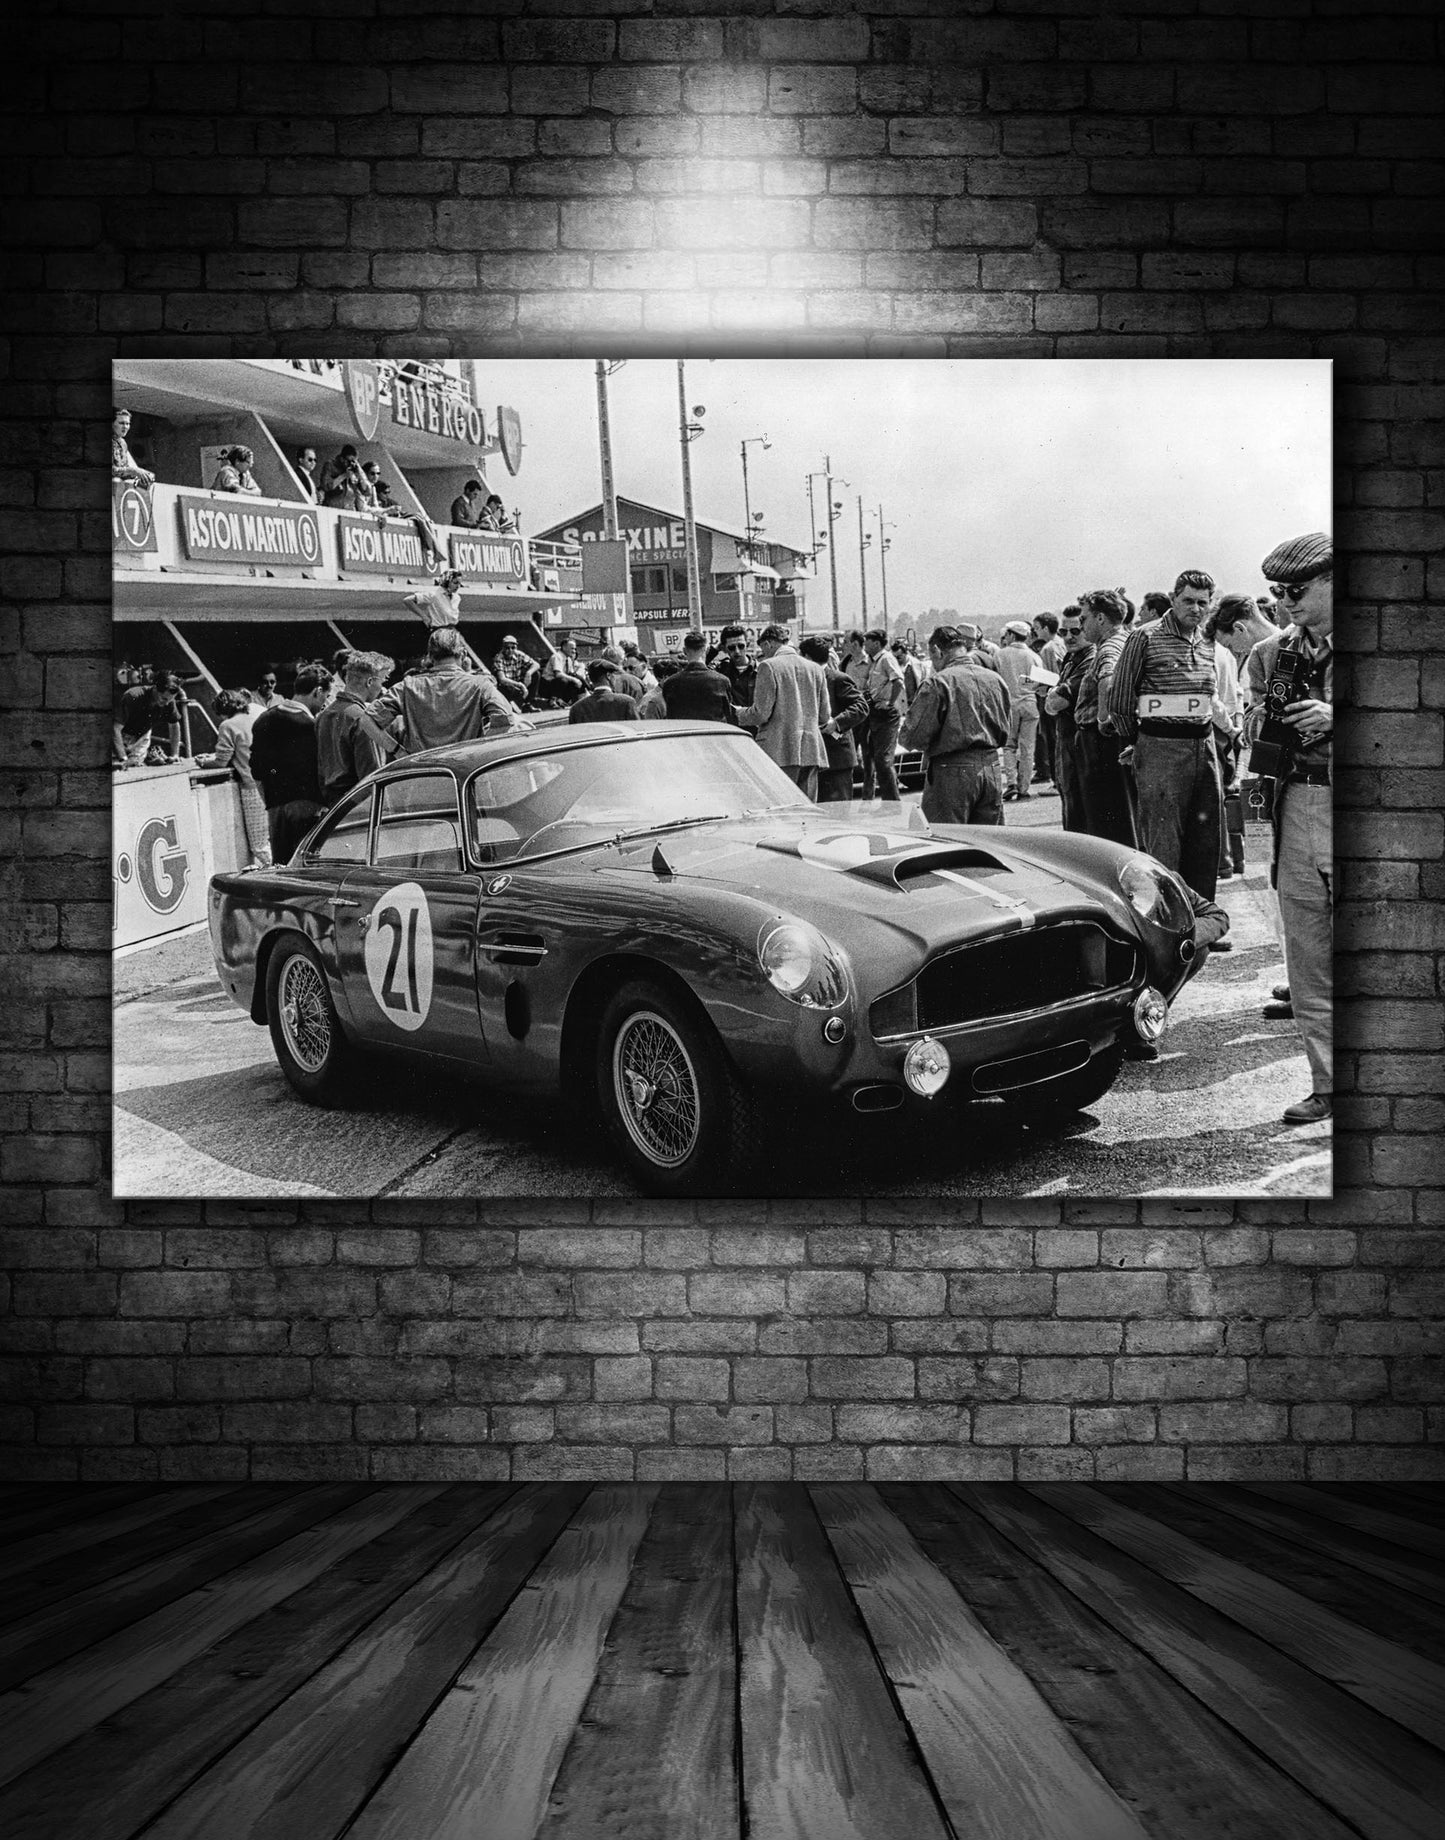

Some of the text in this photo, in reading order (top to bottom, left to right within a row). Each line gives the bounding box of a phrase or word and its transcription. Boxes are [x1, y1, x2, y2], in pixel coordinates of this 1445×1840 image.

[351, 369, 376, 416] BP
[393, 378, 493, 449] ENERGOL
[127, 500, 140, 535] 7
[188, 507, 313, 555] ASTON MARTIN 6
[344, 526, 383, 563] ASTON
[382, 531, 424, 567] MARTIN
[454, 541, 483, 572] ASTON
[632, 608, 692, 620] CAPSULE VER
[665, 635, 679, 646] BP
[1148, 698, 1200, 713] P P
[377, 906, 421, 1014] 21
